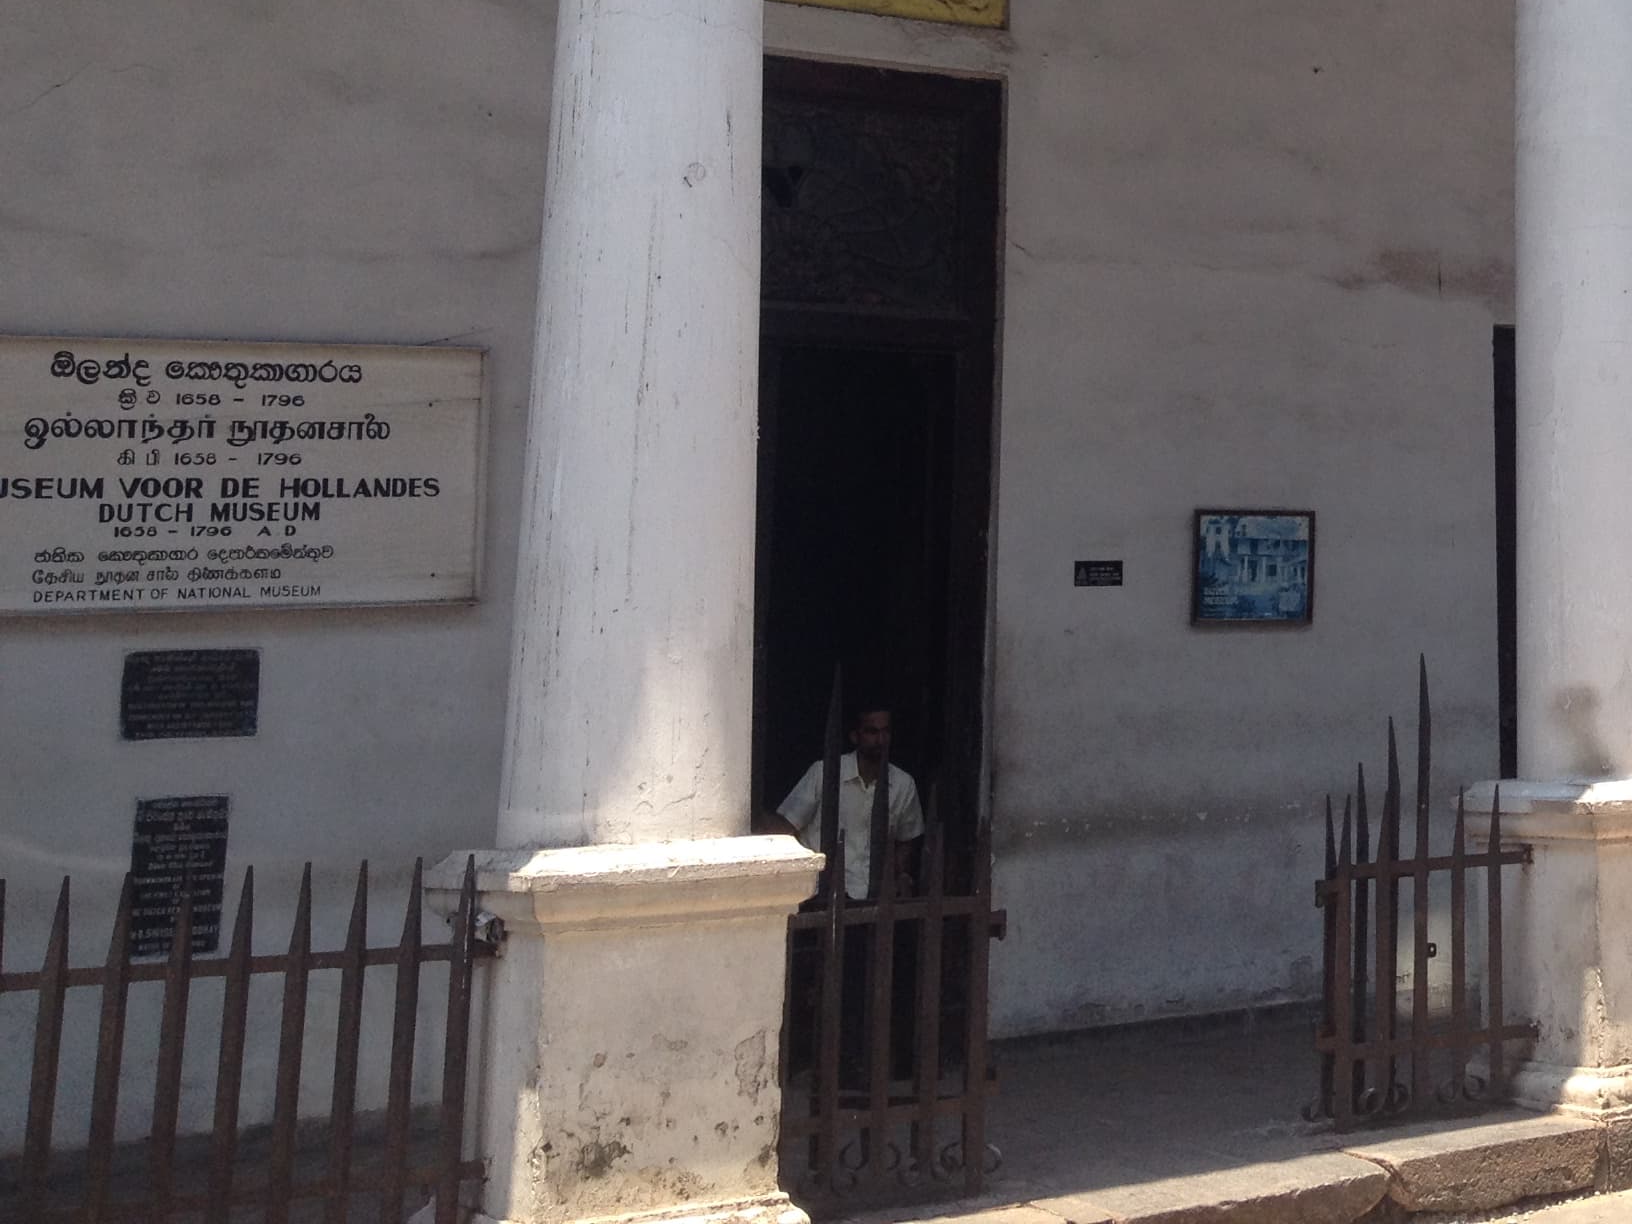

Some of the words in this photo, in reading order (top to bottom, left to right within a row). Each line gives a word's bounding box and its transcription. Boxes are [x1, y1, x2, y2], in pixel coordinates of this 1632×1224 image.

[176, 394, 221, 406] 1658
[261, 395, 305, 407] 1796
[174, 453, 216, 466] 1658
[258, 453, 302, 466] 1796
[119, 478, 203, 499] VOOR
[220, 478, 260, 499] DE
[280, 478, 440, 498] HOLLANDES
[99, 503, 193, 523] DUTCH
[210, 502, 320, 522] MUSEUM
[114, 526, 158, 538] 1658
[190, 526, 232, 537] 1796
[257, 525, 272, 536] A
[285, 525, 297, 536] D
[33, 588, 145, 603] DEPARTMENT
[150, 588, 169, 600] OF
[177, 586, 250, 600] NATIONAL
[260, 585, 321, 598] MUSEUM
